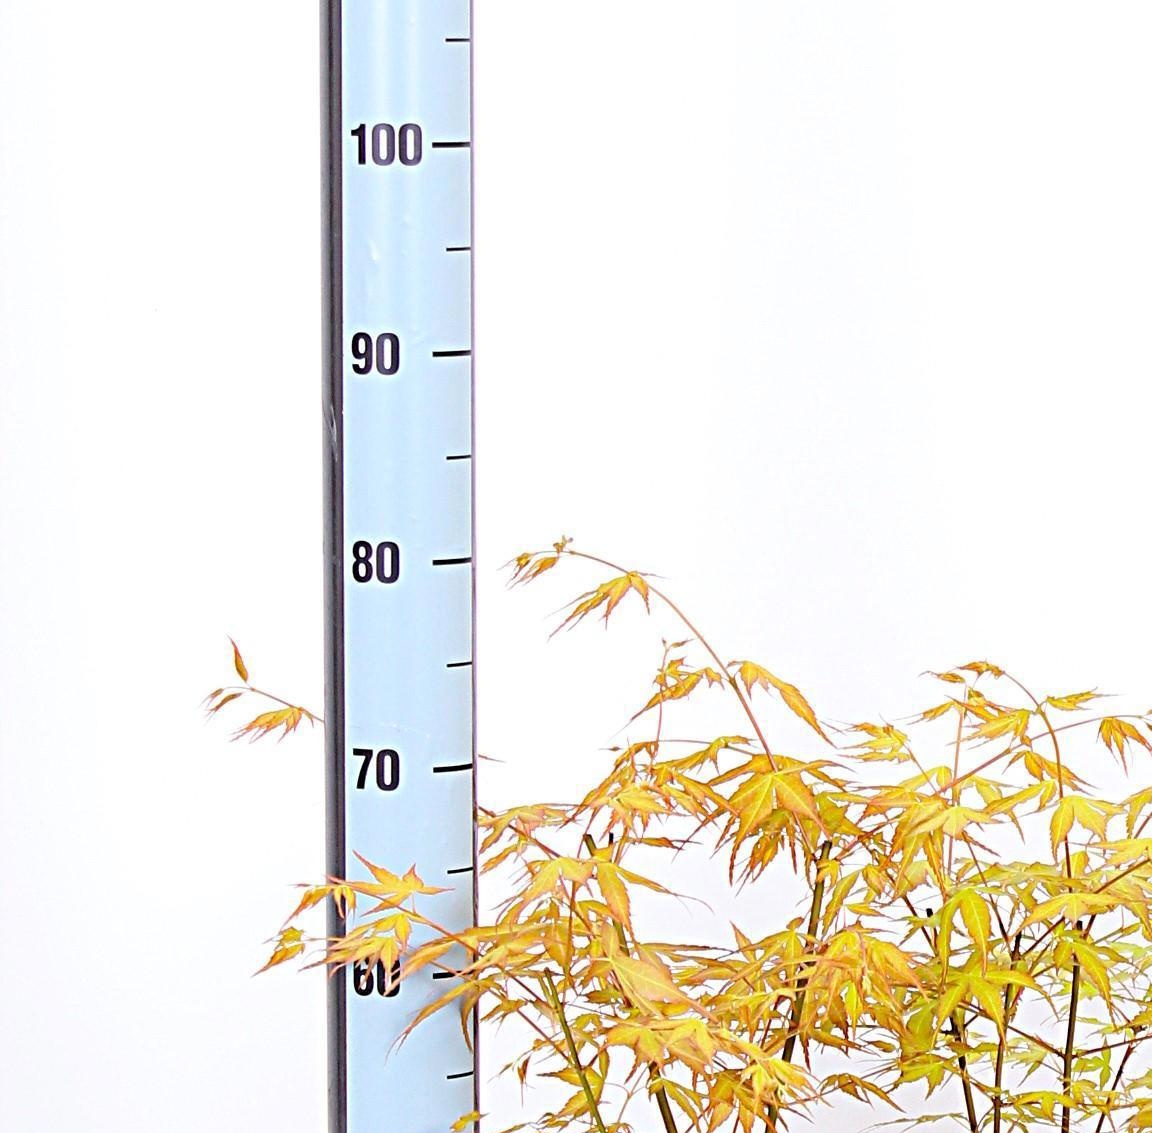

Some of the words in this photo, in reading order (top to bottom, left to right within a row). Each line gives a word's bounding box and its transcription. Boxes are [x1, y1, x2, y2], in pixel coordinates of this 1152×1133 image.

[350, 124, 422, 165] 100
[351, 333, 400, 375] 90
[352, 541, 400, 583] 80
[352, 749, 400, 791] 70
[353, 955, 401, 997] 60
